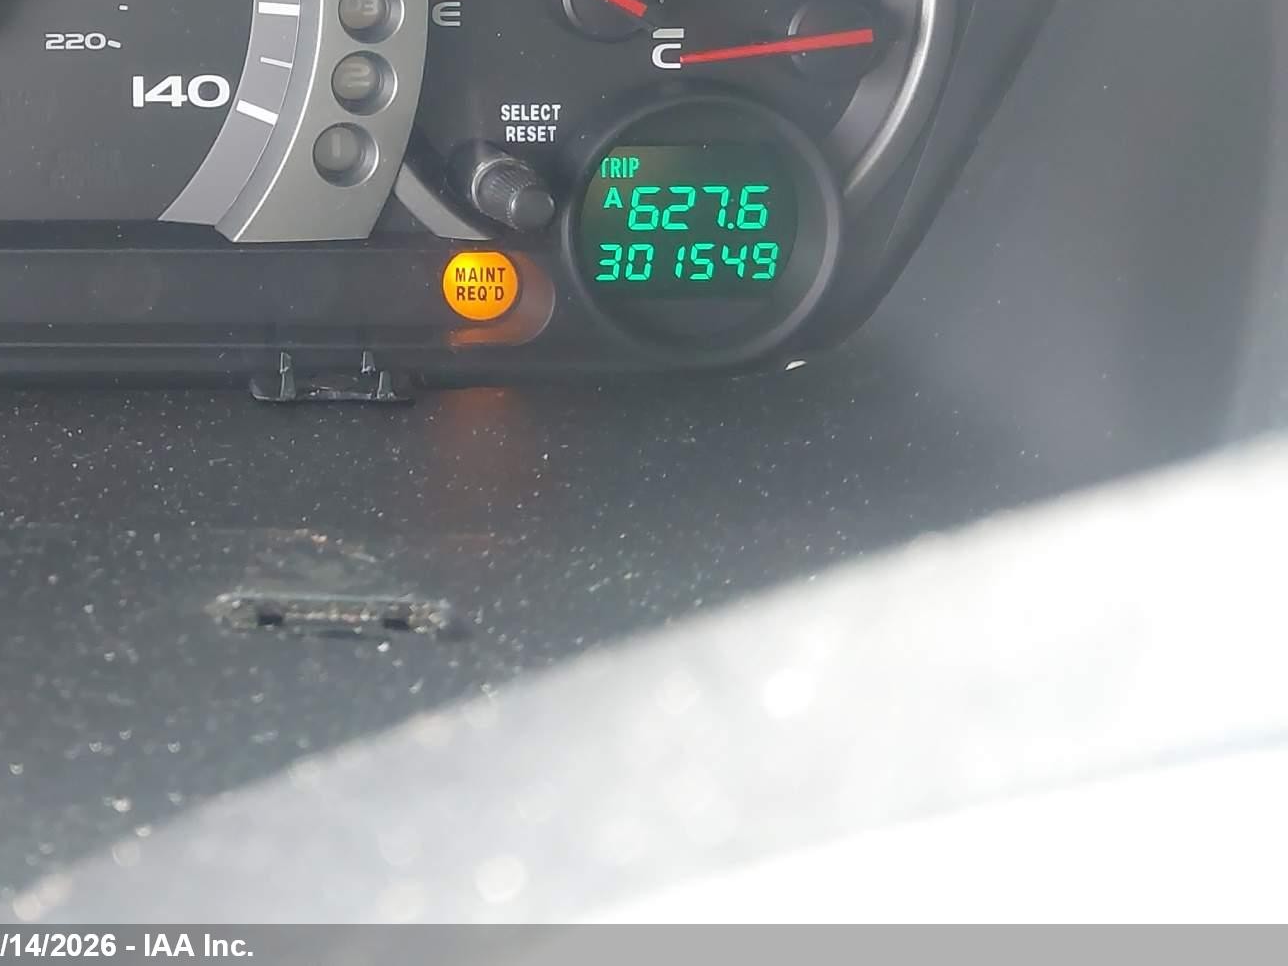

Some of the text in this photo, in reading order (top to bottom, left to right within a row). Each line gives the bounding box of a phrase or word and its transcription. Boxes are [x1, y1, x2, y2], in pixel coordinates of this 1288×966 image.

[432, 1, 461, 27] E
[45, 33, 107, 50] 220
[652, 43, 681, 70] C
[132, 75, 230, 108] 140
[500, 104, 561, 122] SELECT
[505, 125, 557, 142] RESET
[600, 157, 640, 178] TRIP
[603, 185, 770, 231] A 627.6
[595, 242, 779, 281] 301549
[455, 267, 506, 283] MAINT
[456, 285, 505, 302] REQ'D
